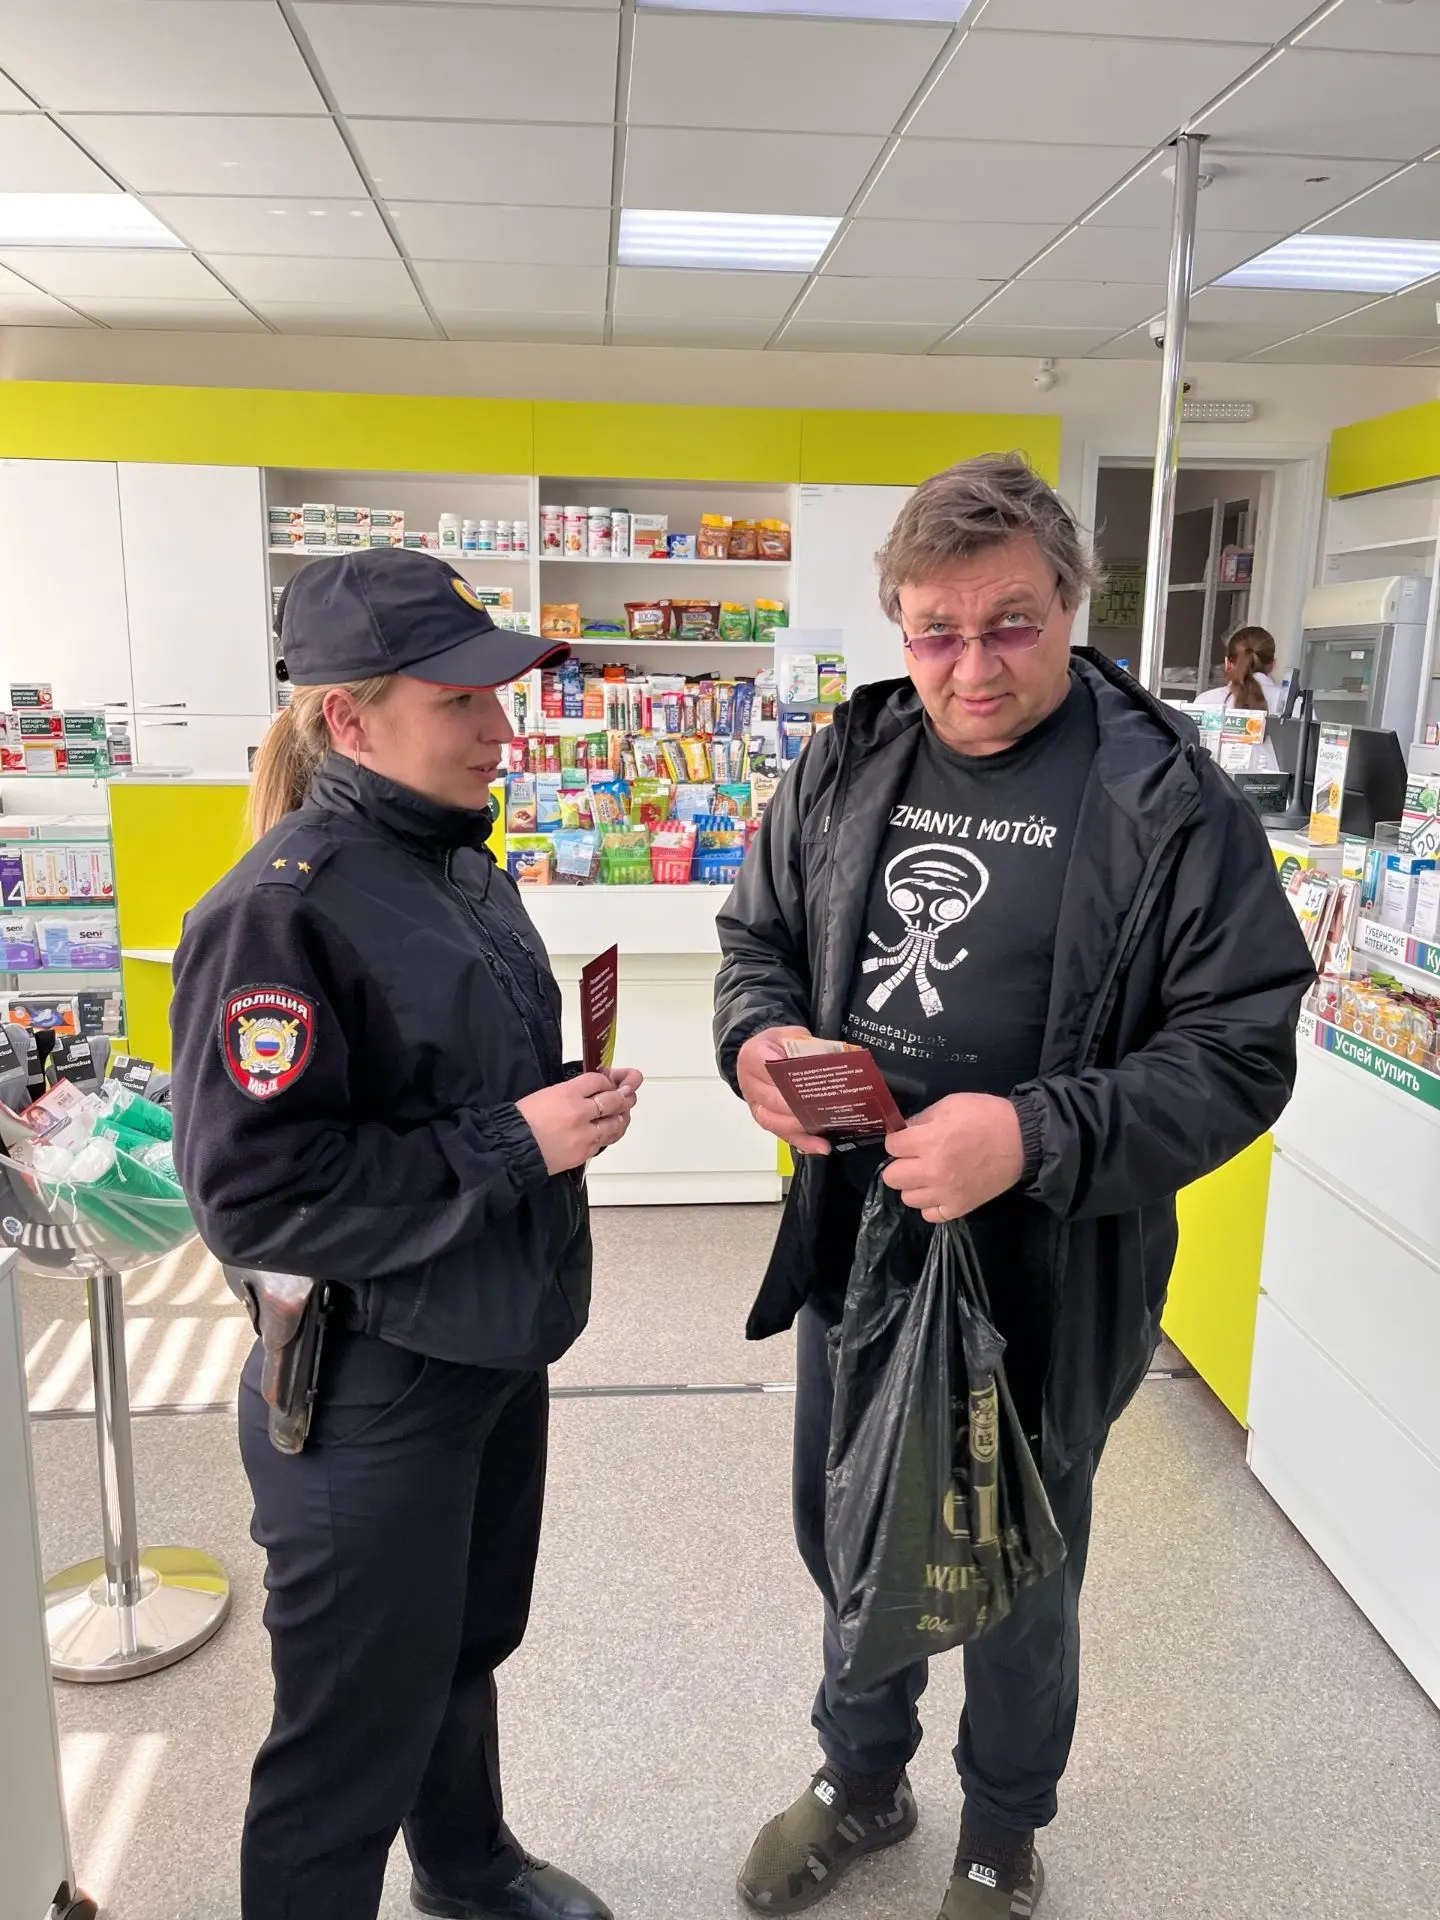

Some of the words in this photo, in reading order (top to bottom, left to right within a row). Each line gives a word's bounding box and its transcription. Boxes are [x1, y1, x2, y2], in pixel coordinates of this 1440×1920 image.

[6, 924, 23, 932] seni
[79, 930, 103, 939] seni
[1365, 925, 1405, 948] ГУБЕРНСКИЕ
[231, 994, 308, 1020] ПОЛИЦИЯ
[1334, 1031, 1372, 1067] Успей
[1374, 1056, 1420, 1092] купить
[247, 1076, 279, 1097] МВД
